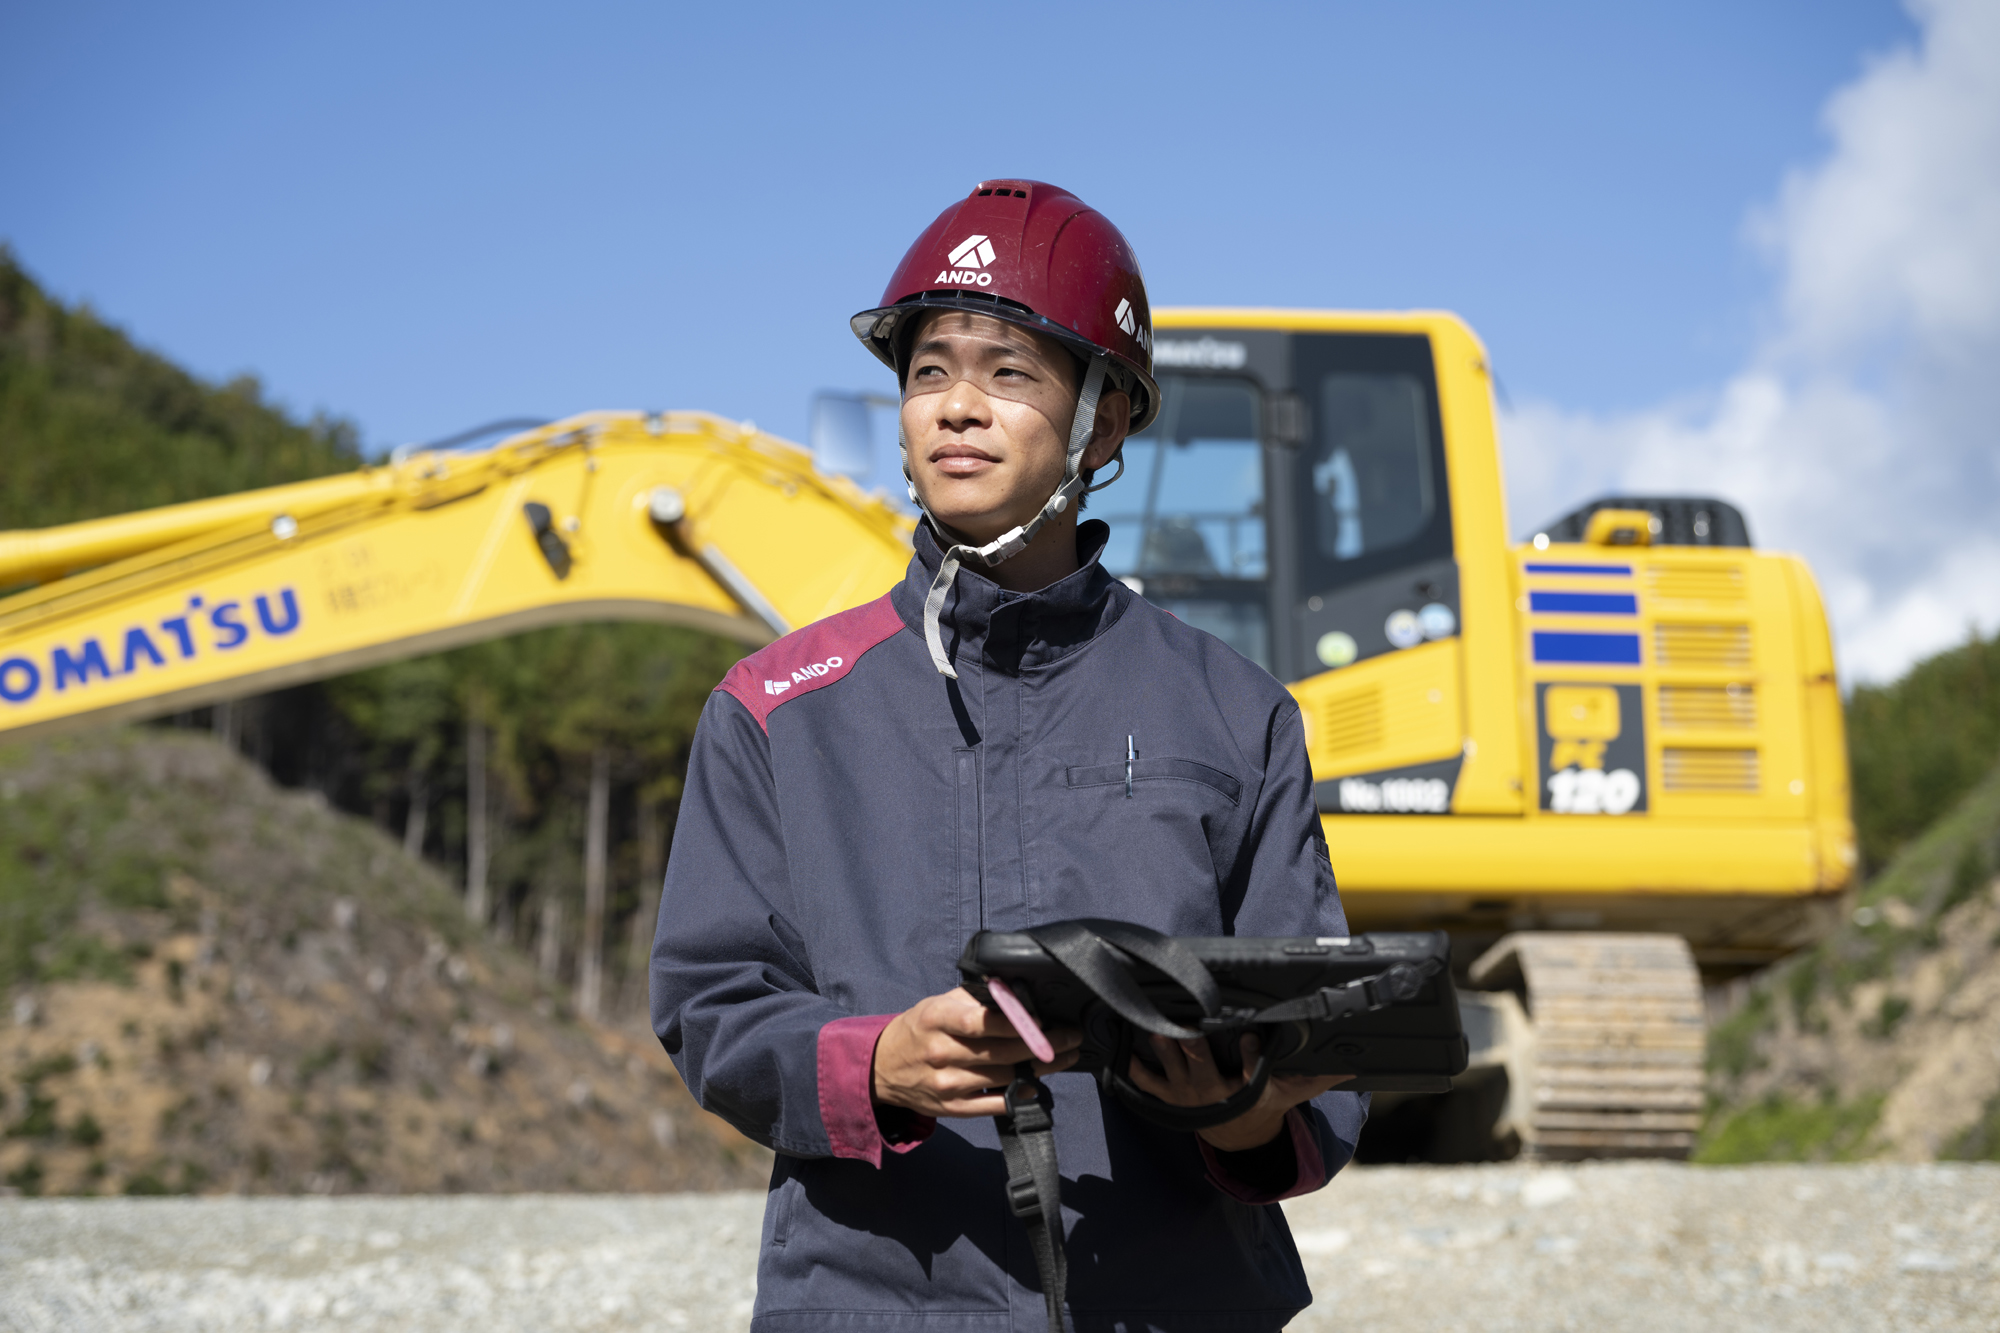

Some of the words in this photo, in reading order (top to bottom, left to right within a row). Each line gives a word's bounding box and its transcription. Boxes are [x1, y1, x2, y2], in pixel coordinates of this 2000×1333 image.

[934, 270, 992, 287] ANDO
[791, 656, 843, 684] ANDO
[1547, 767, 1641, 815] 120
